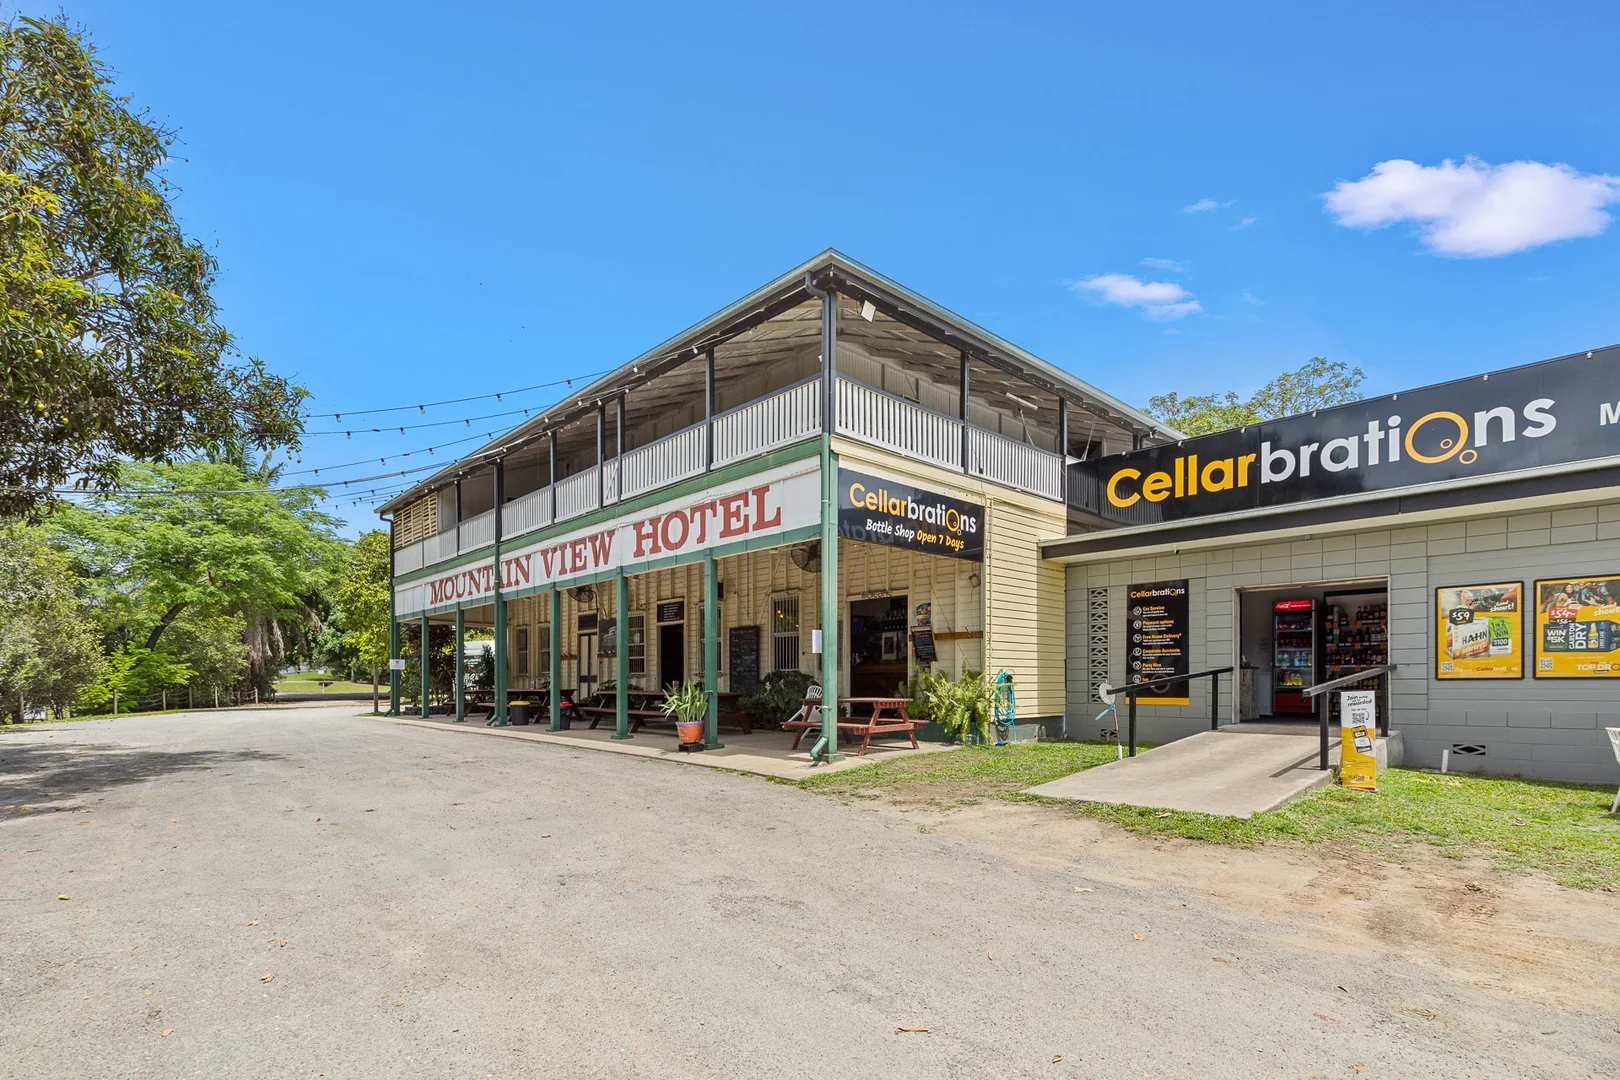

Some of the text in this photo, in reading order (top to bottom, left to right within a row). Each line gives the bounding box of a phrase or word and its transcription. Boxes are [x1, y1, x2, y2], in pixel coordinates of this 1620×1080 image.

[1107, 398, 1556, 507] Cellarbrations
[849, 482, 976, 536] Cellarbrations
[541, 530, 616, 579] VIEW
[633, 485, 782, 558] HOTEL
[865, 518, 893, 535] Bottle
[894, 523, 915, 542] Shop
[916, 528, 937, 544] Open
[939, 534, 944, 544] 7
[945, 535, 965, 551] Days
[1130, 587, 1185, 599] Cellarbrations
[1452, 611, 1470, 621] $59
[1462, 630, 1487, 645] HAHN
[1575, 623, 1586, 649] DRY
